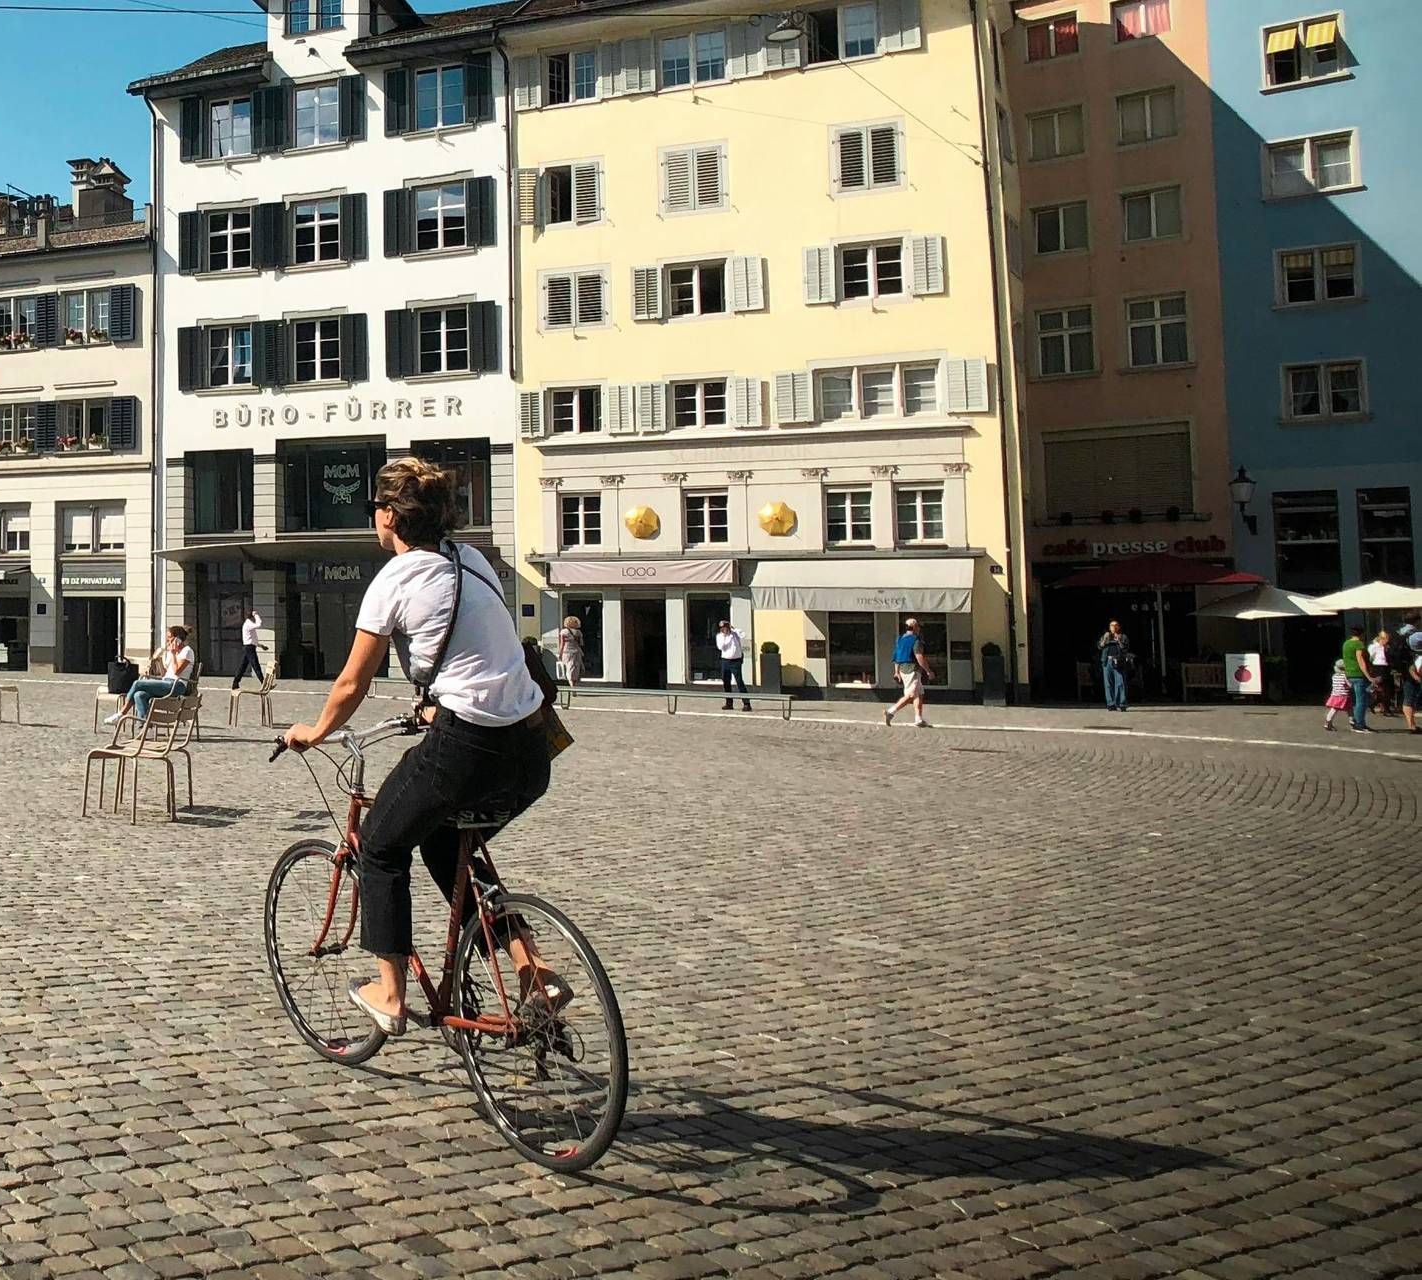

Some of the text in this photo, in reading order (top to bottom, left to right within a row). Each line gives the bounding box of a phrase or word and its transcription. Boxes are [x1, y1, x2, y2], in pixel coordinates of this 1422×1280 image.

[324, 463, 361, 479] MCM
[1042, 535, 1226, 559] café presse club
[324, 566, 361, 580] MCM
[622, 567, 656, 577] LOOQ
[70, 577, 122, 585] DZ PRIVATBANK
